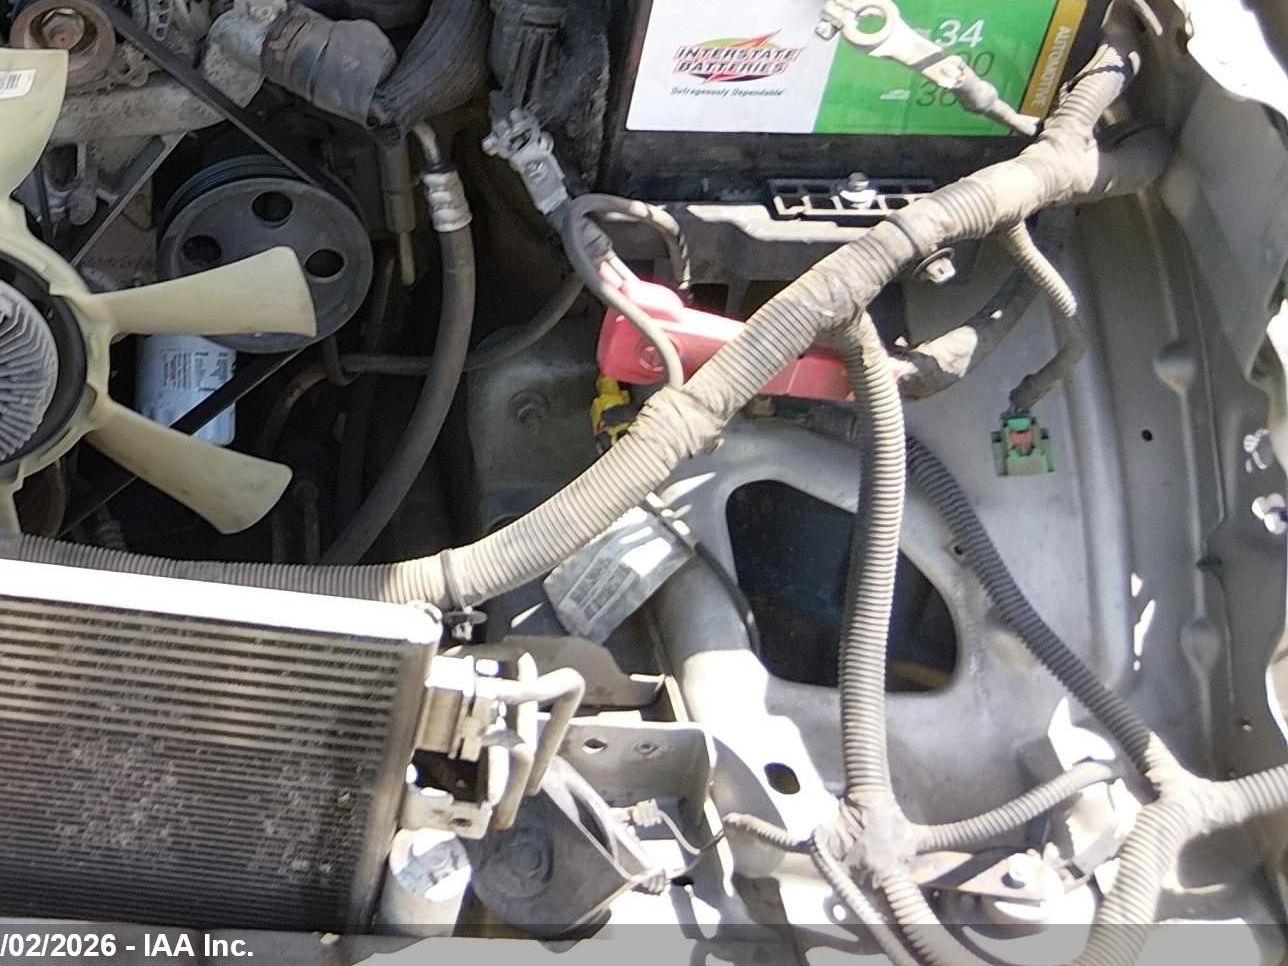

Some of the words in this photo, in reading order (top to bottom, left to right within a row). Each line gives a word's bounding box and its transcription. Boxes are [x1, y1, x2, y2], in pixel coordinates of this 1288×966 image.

[935, 19, 985, 48] 34
[675, 46, 800, 60] INTERSTATE
[675, 60, 788, 74] BATTERIES
[1031, 25, 1072, 107] AUTOMOTIVE
